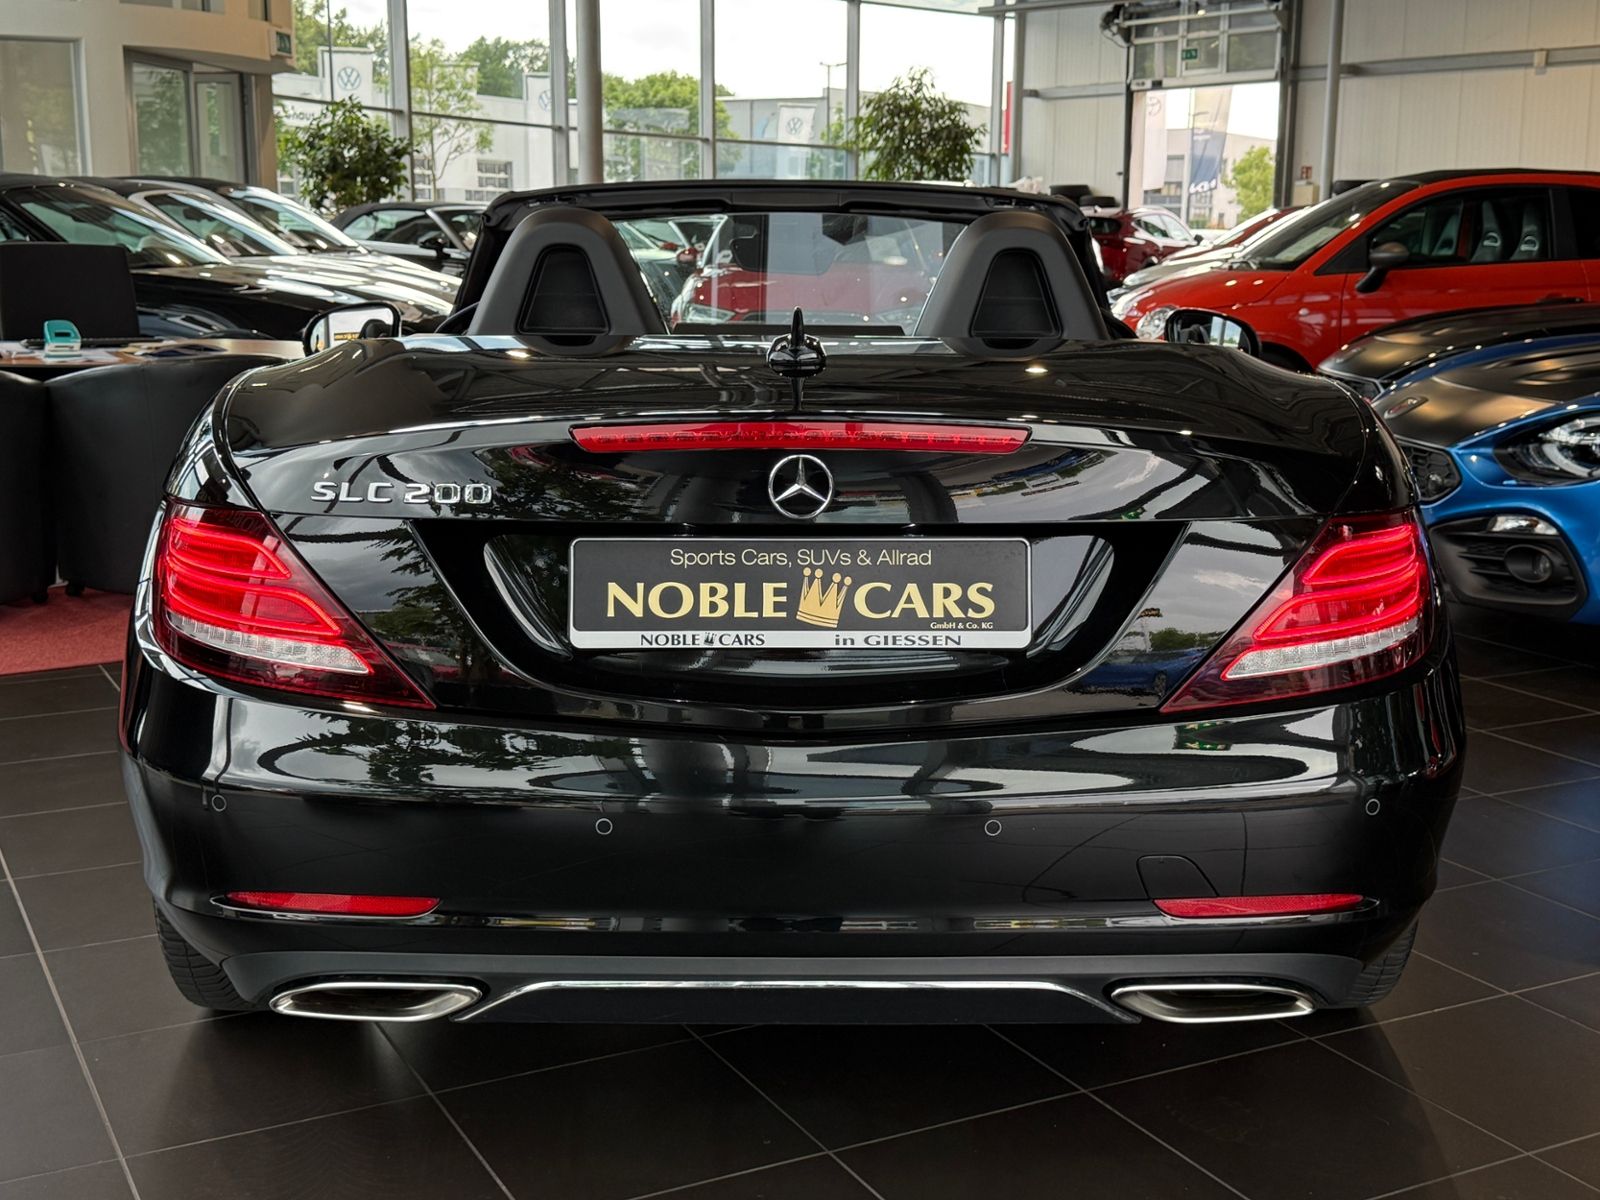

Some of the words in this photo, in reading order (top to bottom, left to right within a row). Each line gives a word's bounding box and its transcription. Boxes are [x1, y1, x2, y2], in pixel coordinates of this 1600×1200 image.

[310, 481, 393, 503] SLC
[403, 483, 492, 504] 200
[670, 549, 736, 569] Sports
[741, 549, 792, 569] Cars,
[797, 549, 851, 566] SUVs
[857, 549, 872, 566] &
[876, 549, 932, 566] Allrad
[606, 582, 788, 619] NOBLE
[853, 582, 996, 619] CARS
[640, 634, 700, 646] NOBLE
[718, 634, 766, 646] CARS
[835, 634, 855, 646] in
[864, 634, 962, 646] GIESSEN
